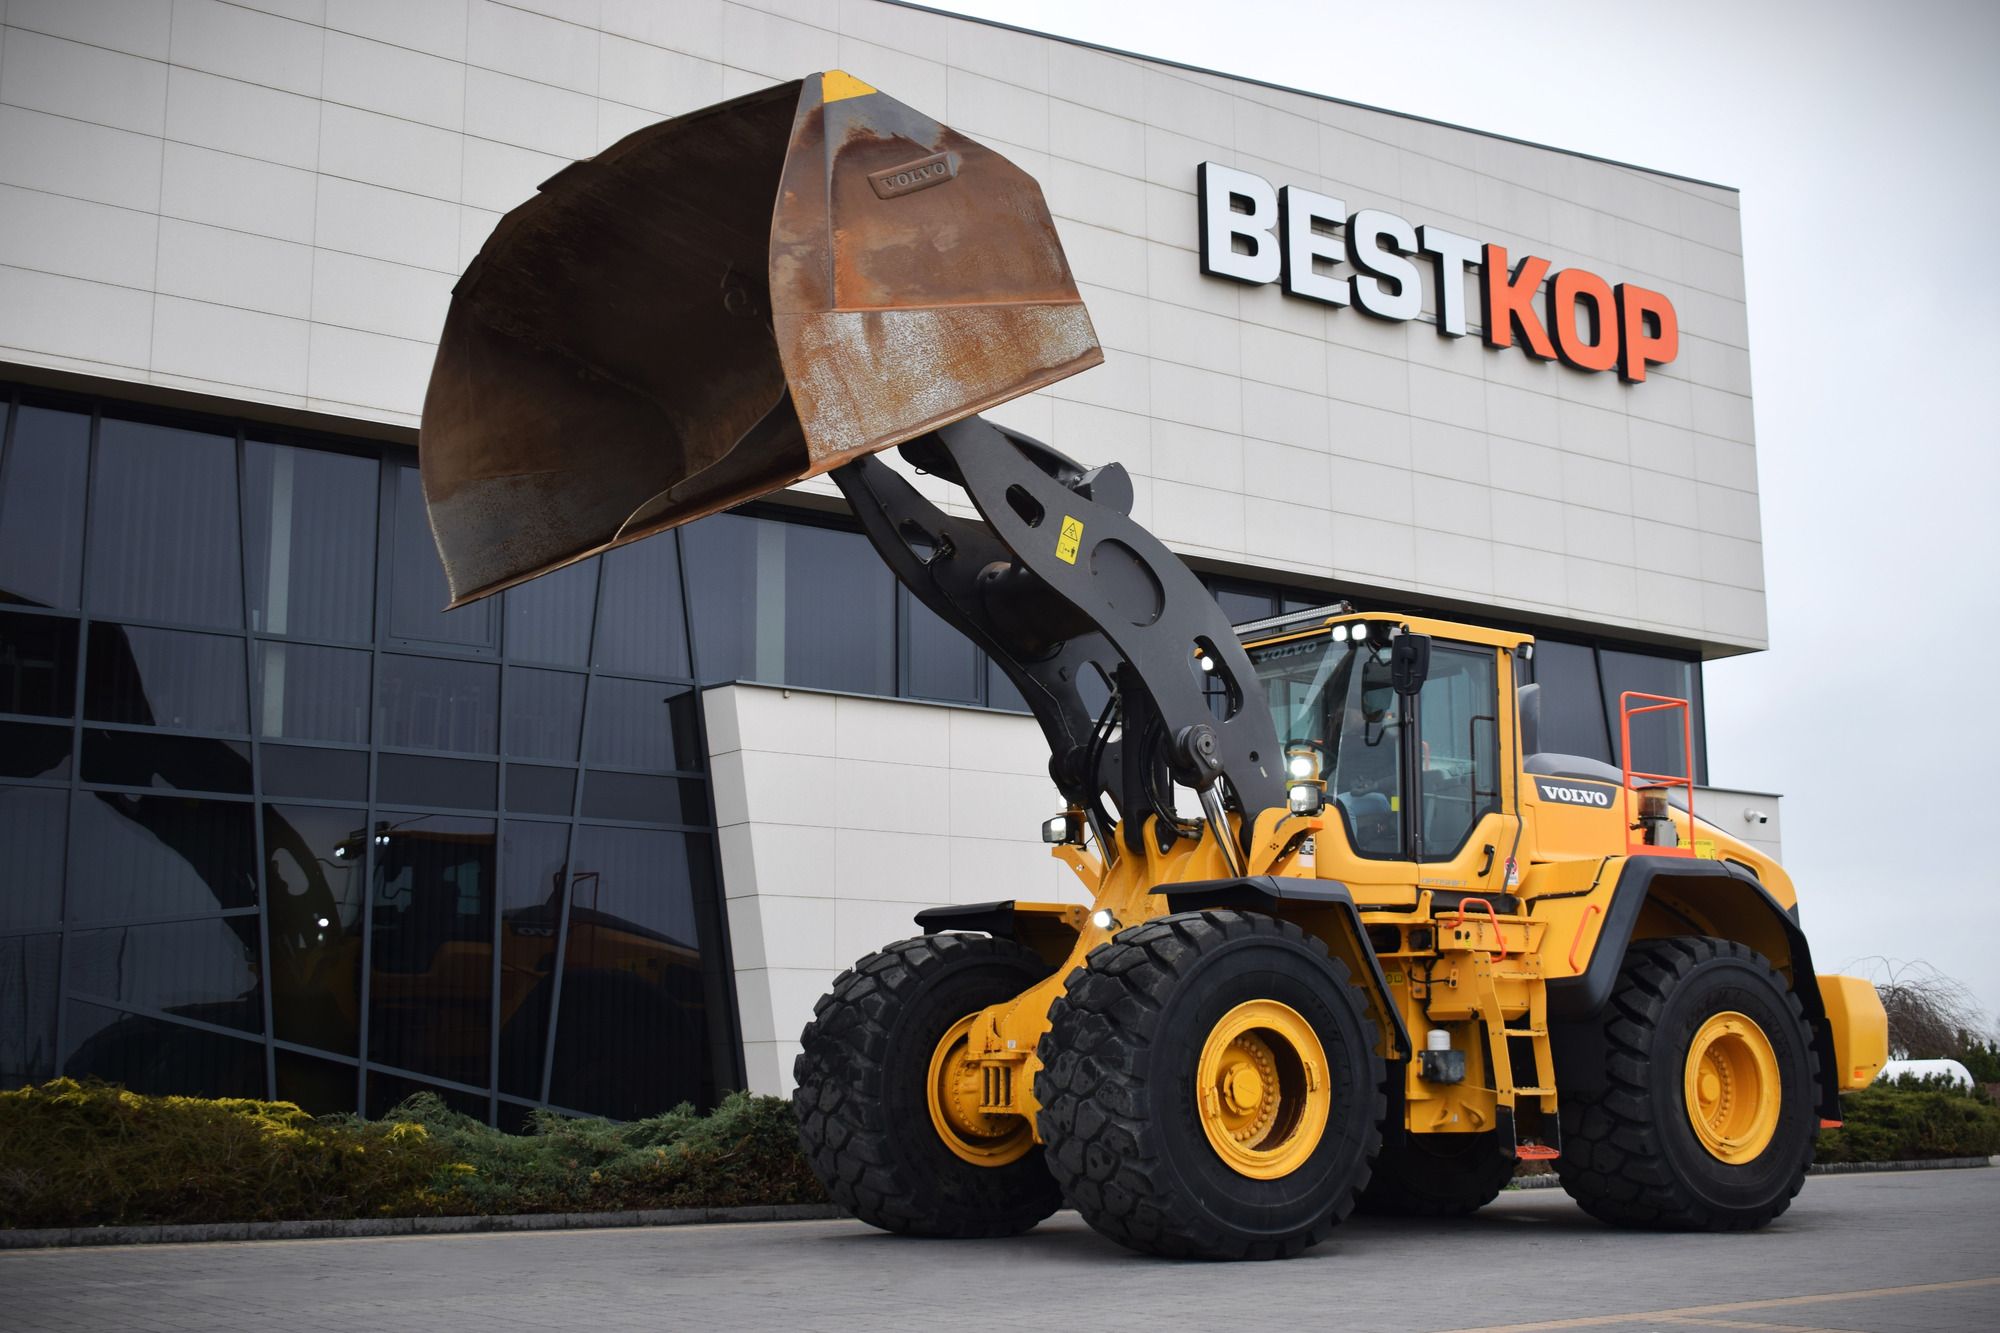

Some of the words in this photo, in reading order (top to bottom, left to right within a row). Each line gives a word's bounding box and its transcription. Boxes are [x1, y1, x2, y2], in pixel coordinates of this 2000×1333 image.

[880, 161, 946, 190] VOLVO
[1198, 161, 1679, 383] BESTKOP
[1541, 785, 1608, 806] VOLVO
